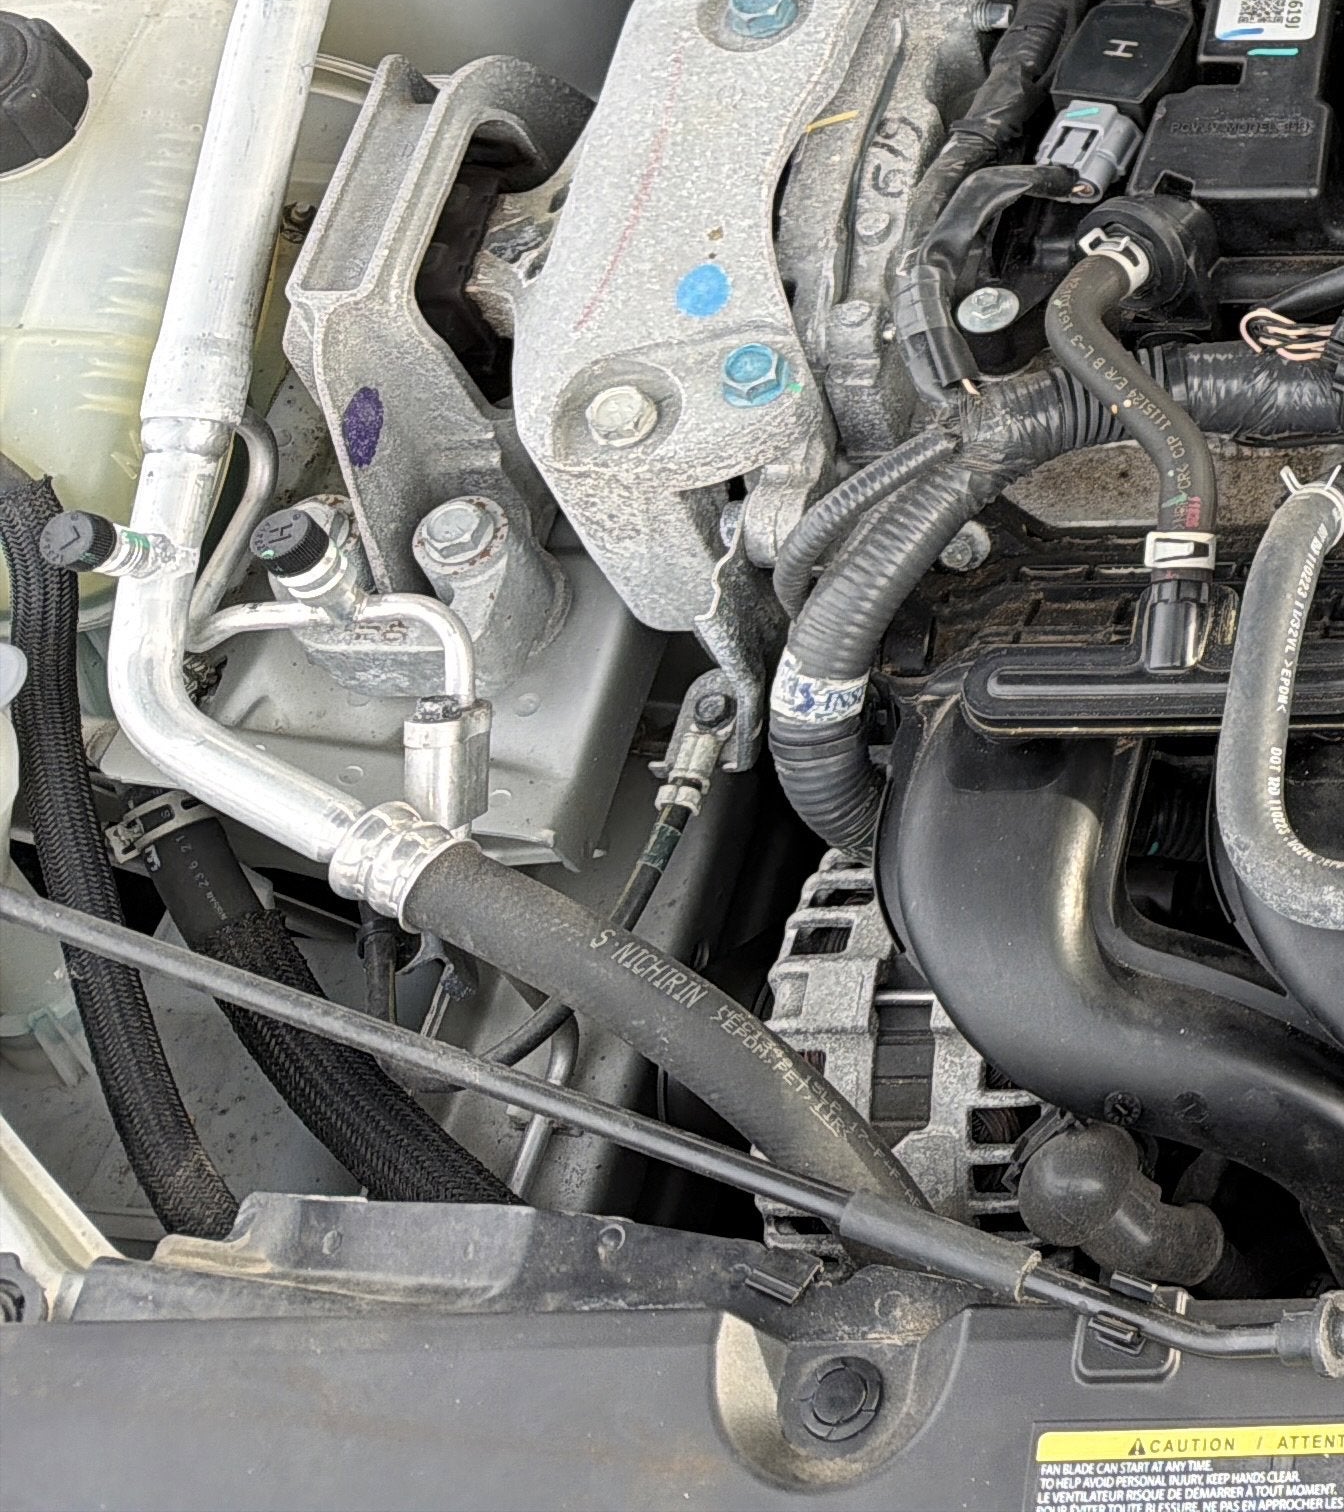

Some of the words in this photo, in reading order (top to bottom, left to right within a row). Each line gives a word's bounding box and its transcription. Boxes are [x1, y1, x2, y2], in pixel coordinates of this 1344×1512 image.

[1149, 1437, 1235, 1454] CAUTION
[1040, 1463, 1060, 1476] FAN
[1062, 1462, 1094, 1475] BLADE
[1096, 1462, 1118, 1475] CAN
[1119, 1461, 1150, 1474] START
[1151, 1461, 1164, 1473] AT
[1165, 1460, 1186, 1472] ANY
[1040, 1477, 1054, 1490] TO
[1055, 1476, 1081, 1489] HELP
[1082, 1476, 1115, 1488] AVOID
[1115, 1474, 1167, 1488] PERSONAL
[1206, 1472, 1230, 1485] KEEP
[1231, 1471, 1266, 1484] HANDS
[1037, 1491, 1051, 1504] LE
[1052, 1490, 1125, 1504] VENTILATEUR
[1125, 1489, 1165, 1502] RISQUE
[1167, 1488, 1182, 1501] DE
[1254, 1484, 1284, 1498] TOUT
[1285, 1482, 1338, 1497] MOMENT.
[1202, 1500, 1218, 1512] NE
[1220, 1500, 1240, 1512] PAS
[1241, 1499, 1257, 1511] EN
[1259, 1497, 1324, 1511] APPROCHER
[1325, 1496, 1344, 1509] LES
